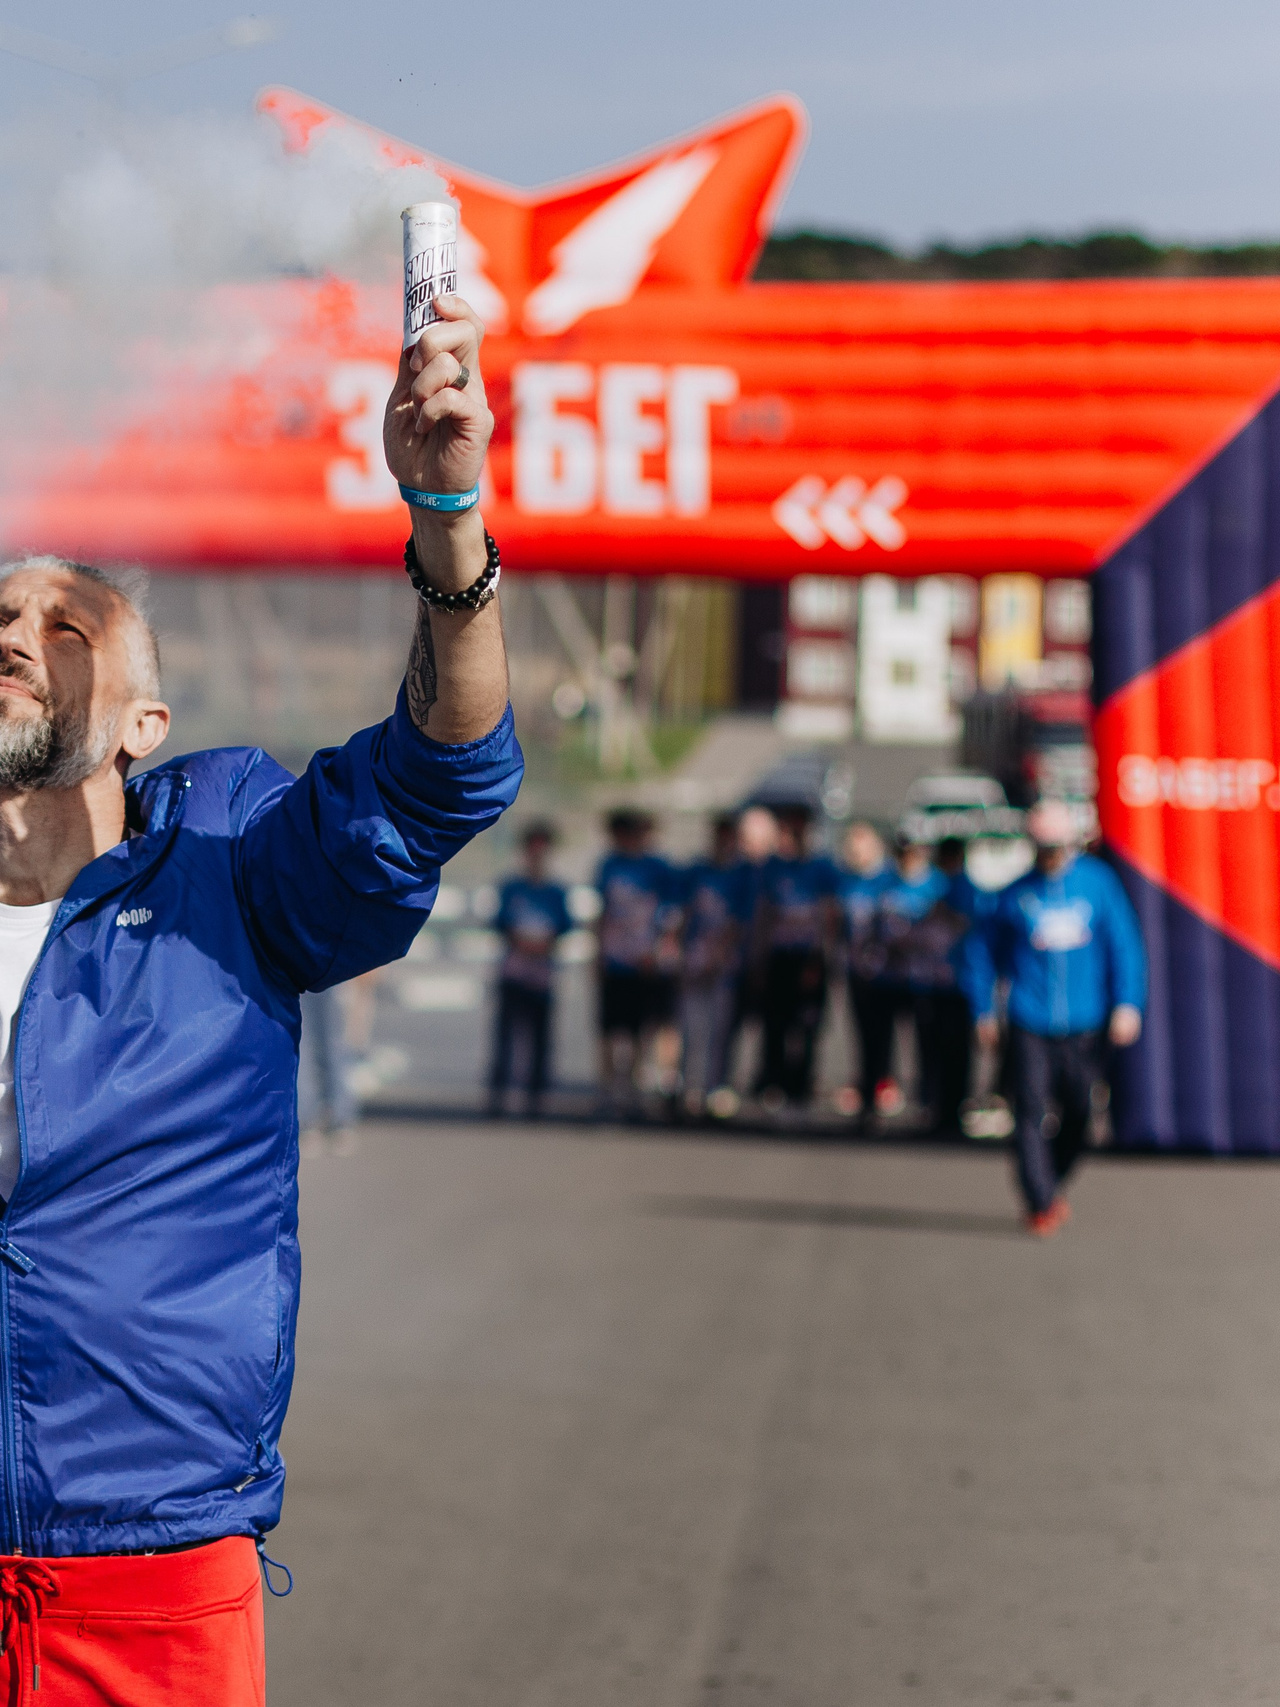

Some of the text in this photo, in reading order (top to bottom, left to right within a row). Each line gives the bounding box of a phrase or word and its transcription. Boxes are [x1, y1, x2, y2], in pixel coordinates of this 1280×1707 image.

[404, 241, 457, 296] SMOKIN
[410, 302, 444, 334] WH
[322, 360, 739, 517] ЗБЕГ
